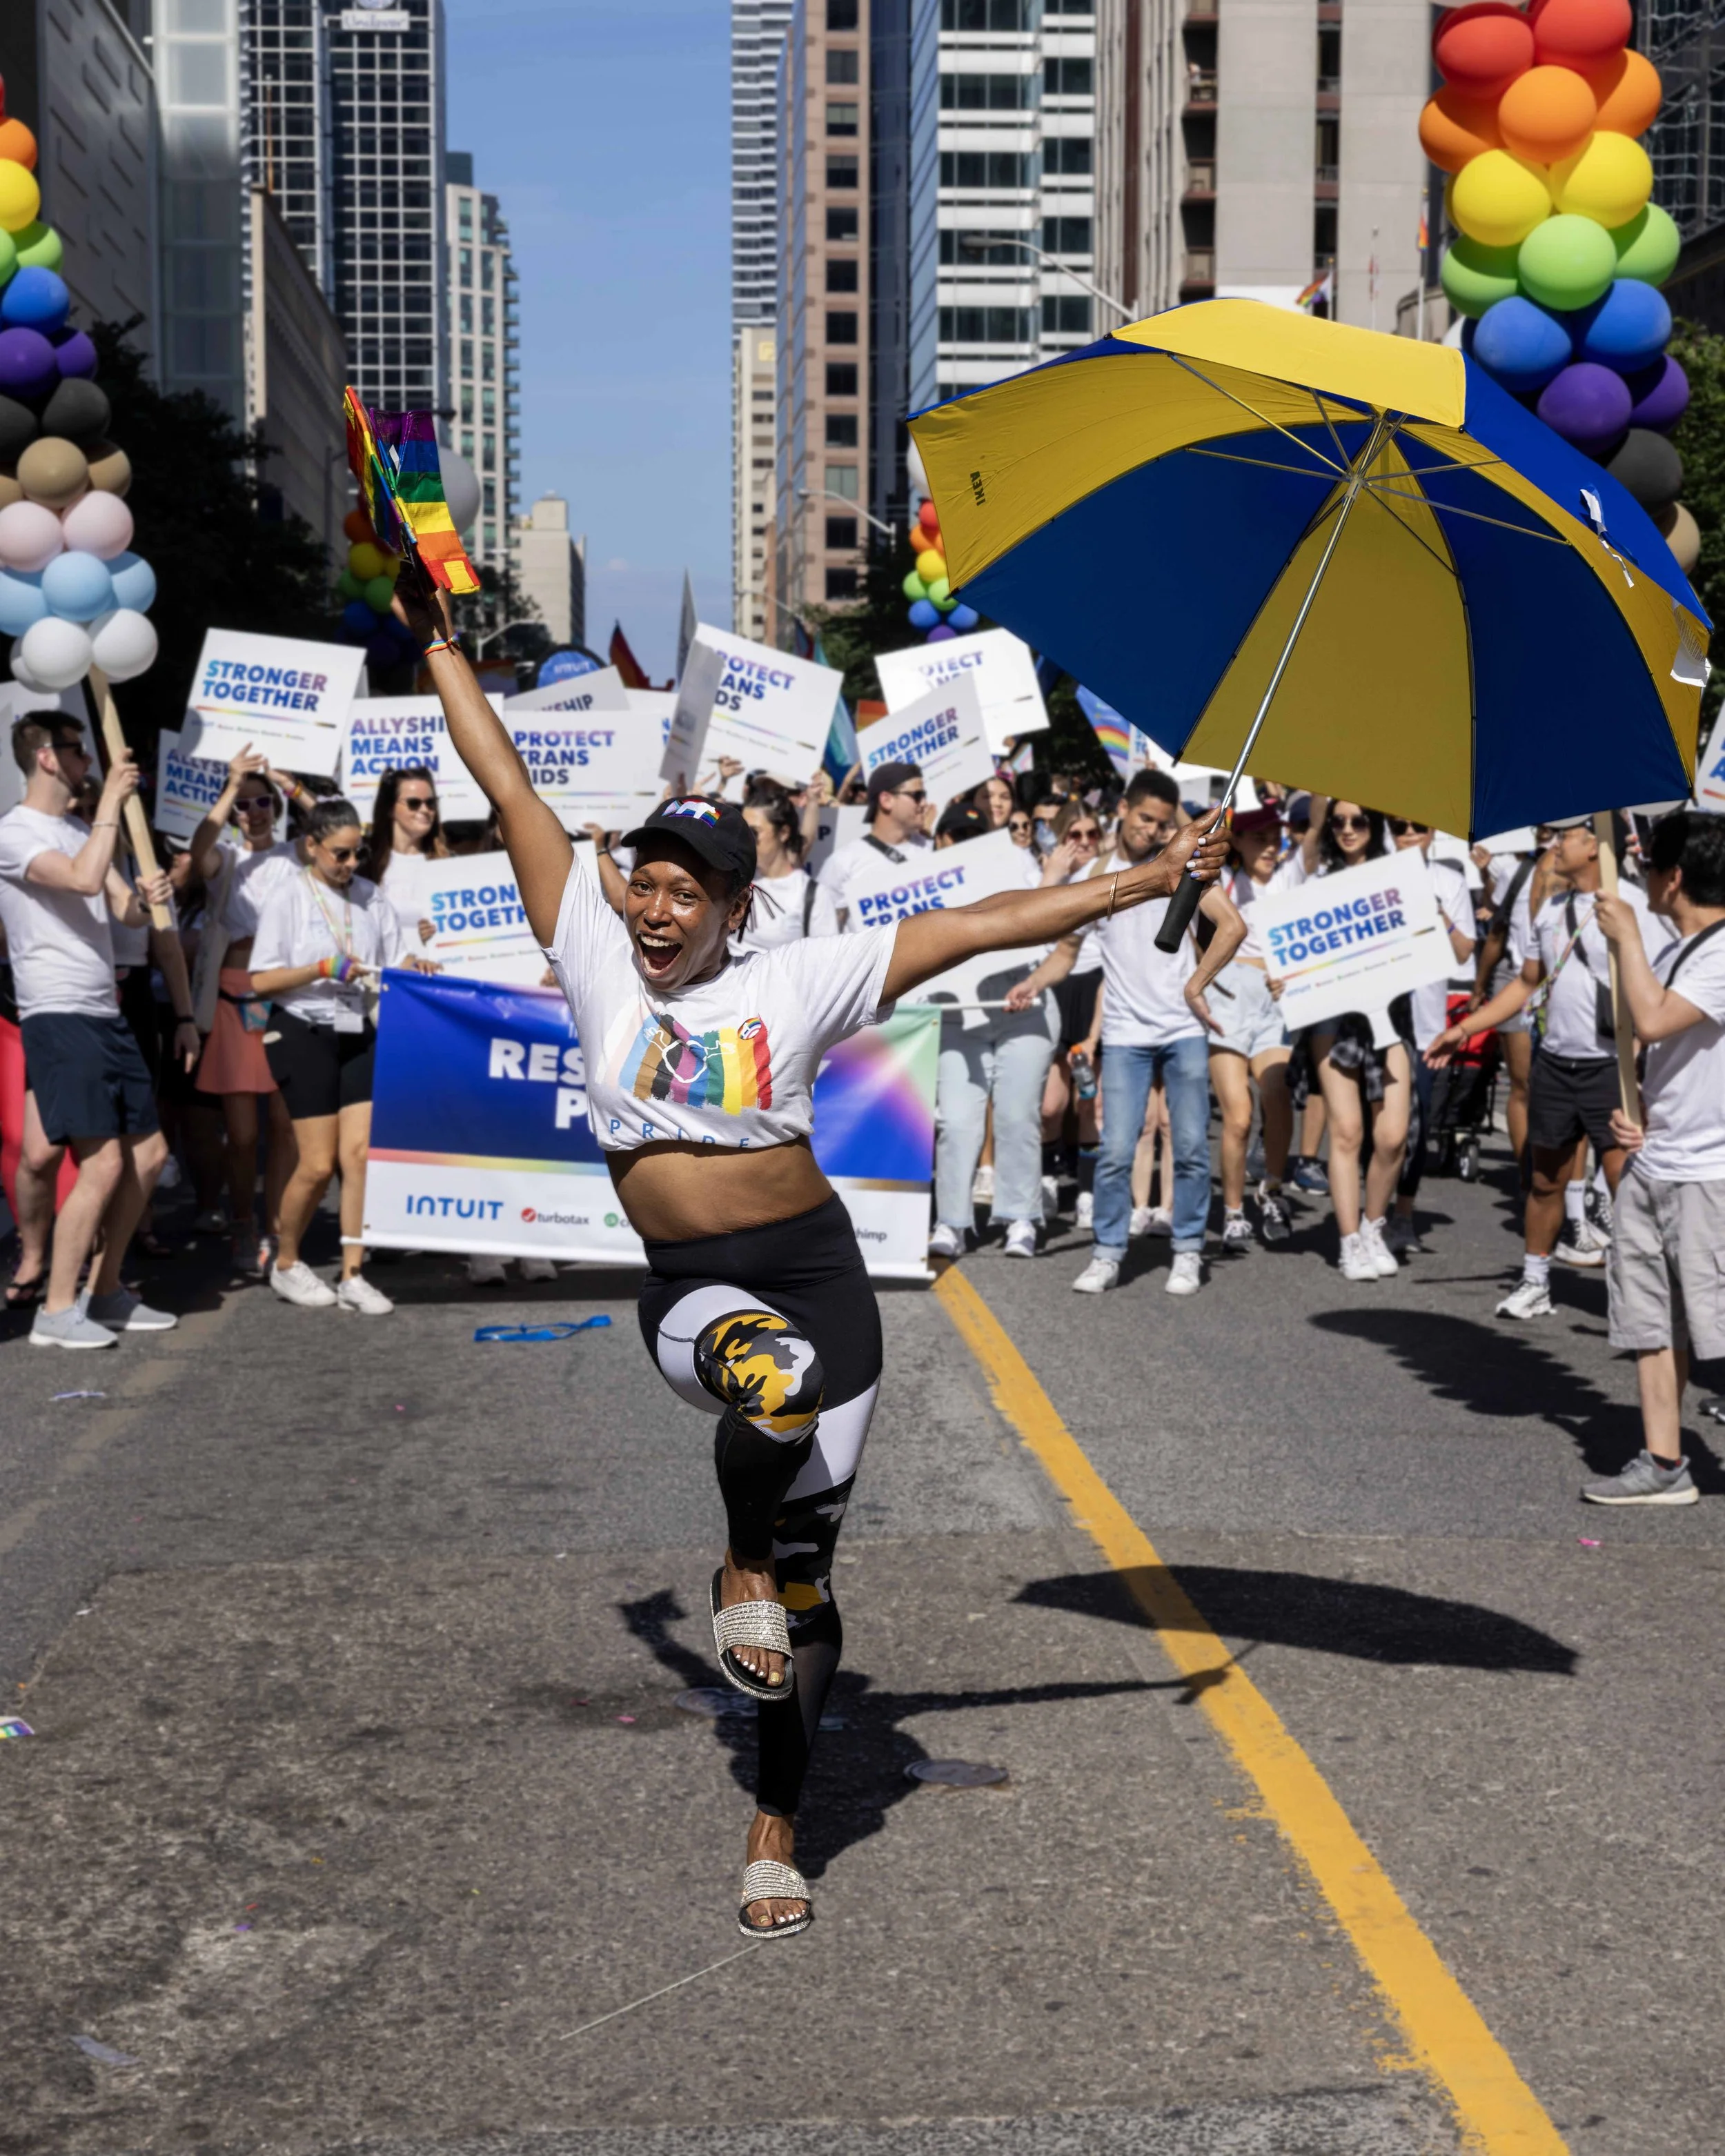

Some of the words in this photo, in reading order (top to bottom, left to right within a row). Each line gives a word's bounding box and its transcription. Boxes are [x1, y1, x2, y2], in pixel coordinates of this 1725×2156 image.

[206, 660, 328, 692] STRONGER
[721, 673, 765, 700] ANS
[202, 680, 319, 712] TOGETHER
[351, 715, 444, 736] ALLYSHI
[514, 730, 615, 747] PROTECT
[868, 707, 959, 768] STRONGER
[351, 736, 433, 755] MEANS
[166, 763, 221, 790] MEAN
[351, 755, 440, 775] ACTION
[532, 769, 569, 785] IDS
[166, 780, 219, 806] ACTIO
[431, 883, 517, 912] STRON
[858, 865, 965, 916] PROTECT
[864, 896, 945, 927] TRANS
[1268, 887, 1403, 947] STRONGER
[1273, 909, 1406, 967] TOGETHER
[489, 1038, 587, 1086] RES
[406, 1194, 504, 1220] INTUIT
[538, 1211, 590, 1225] turbotax
